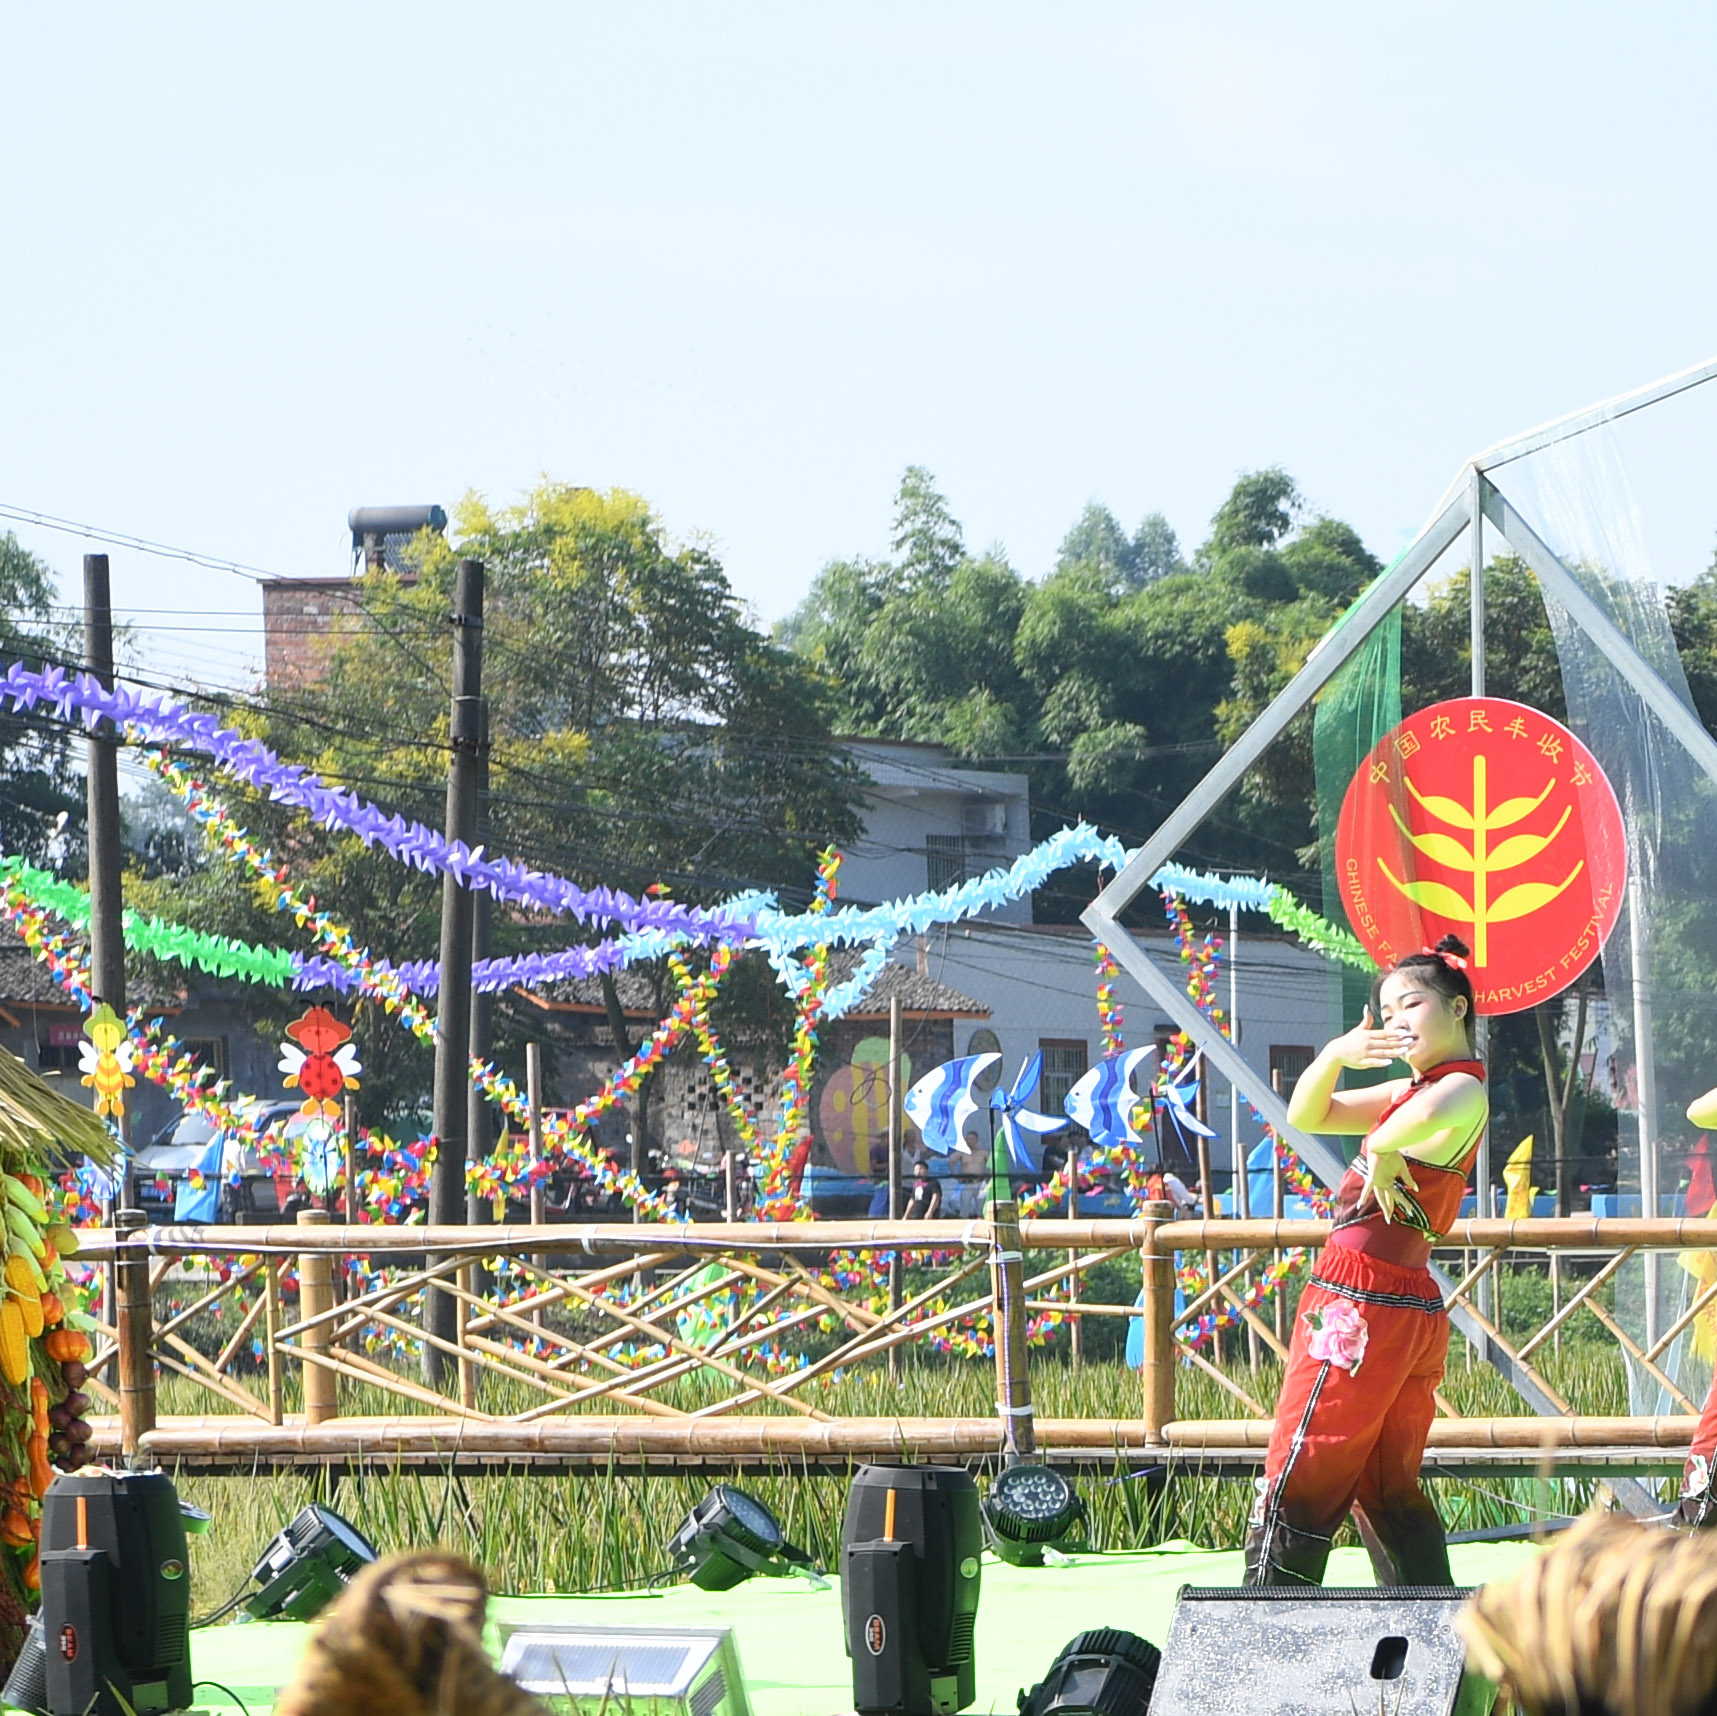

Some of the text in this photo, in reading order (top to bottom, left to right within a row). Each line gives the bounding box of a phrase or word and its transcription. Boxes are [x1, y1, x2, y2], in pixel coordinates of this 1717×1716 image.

[1369, 709, 1593, 787] 中国农民丰收节
[1346, 858, 1380, 940] CHINESE
[1474, 883, 1613, 1004] HARVEST FESTIVAL
[66, 1629, 74, 1657] BEAM
